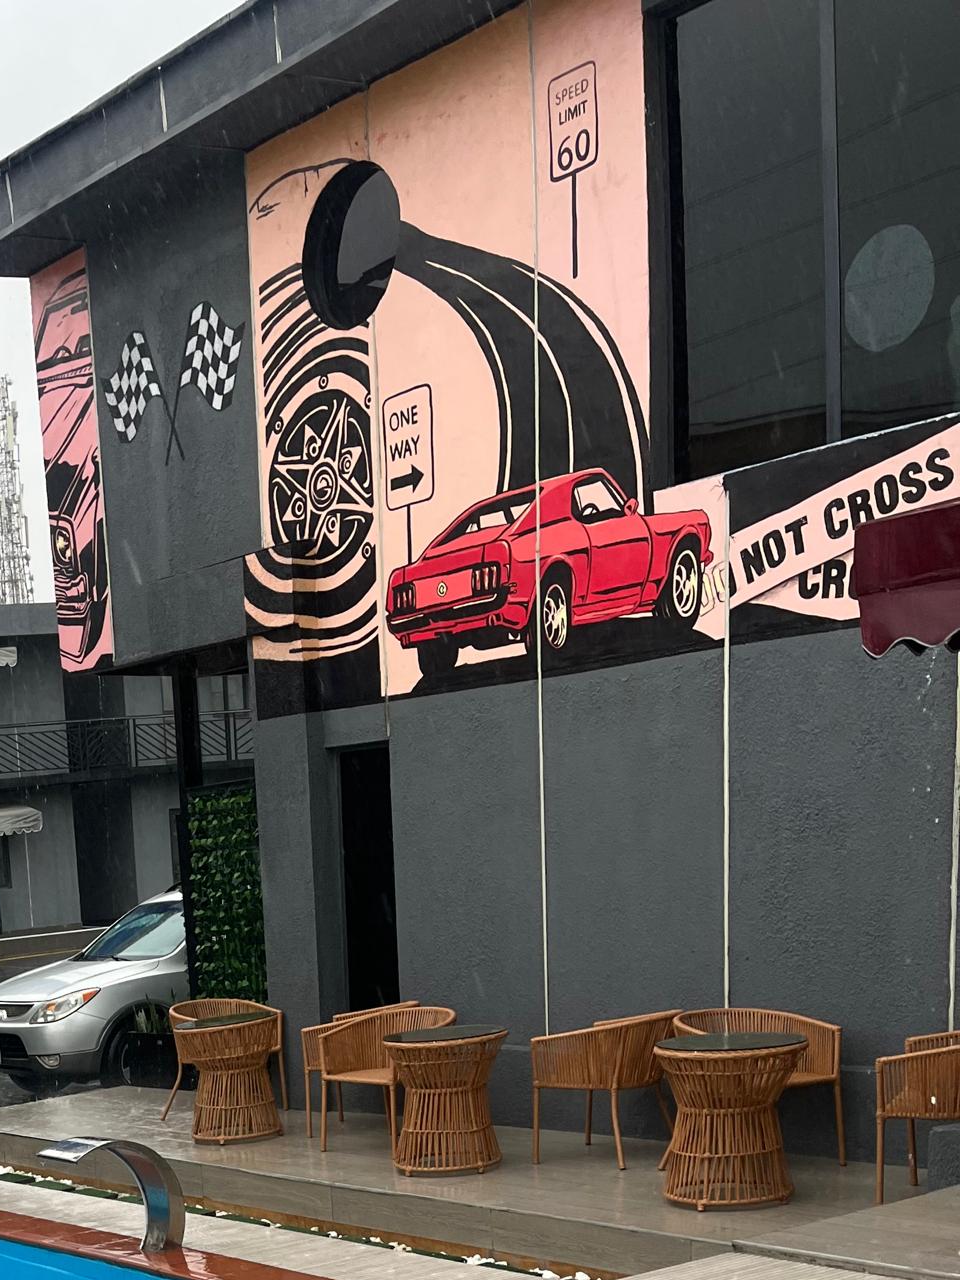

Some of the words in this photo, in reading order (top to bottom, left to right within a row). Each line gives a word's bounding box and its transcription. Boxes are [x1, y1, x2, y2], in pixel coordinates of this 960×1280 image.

[555, 78, 589, 106] SPEED
[558, 100, 588, 126] LIMIT
[557, 128, 590, 171] 60
[389, 404, 419, 432] ONE
[389, 434, 420, 462] WAY
[740, 515, 808, 584] NOT
[823, 447, 955, 540] CROSS
[797, 559, 857, 600] CR
